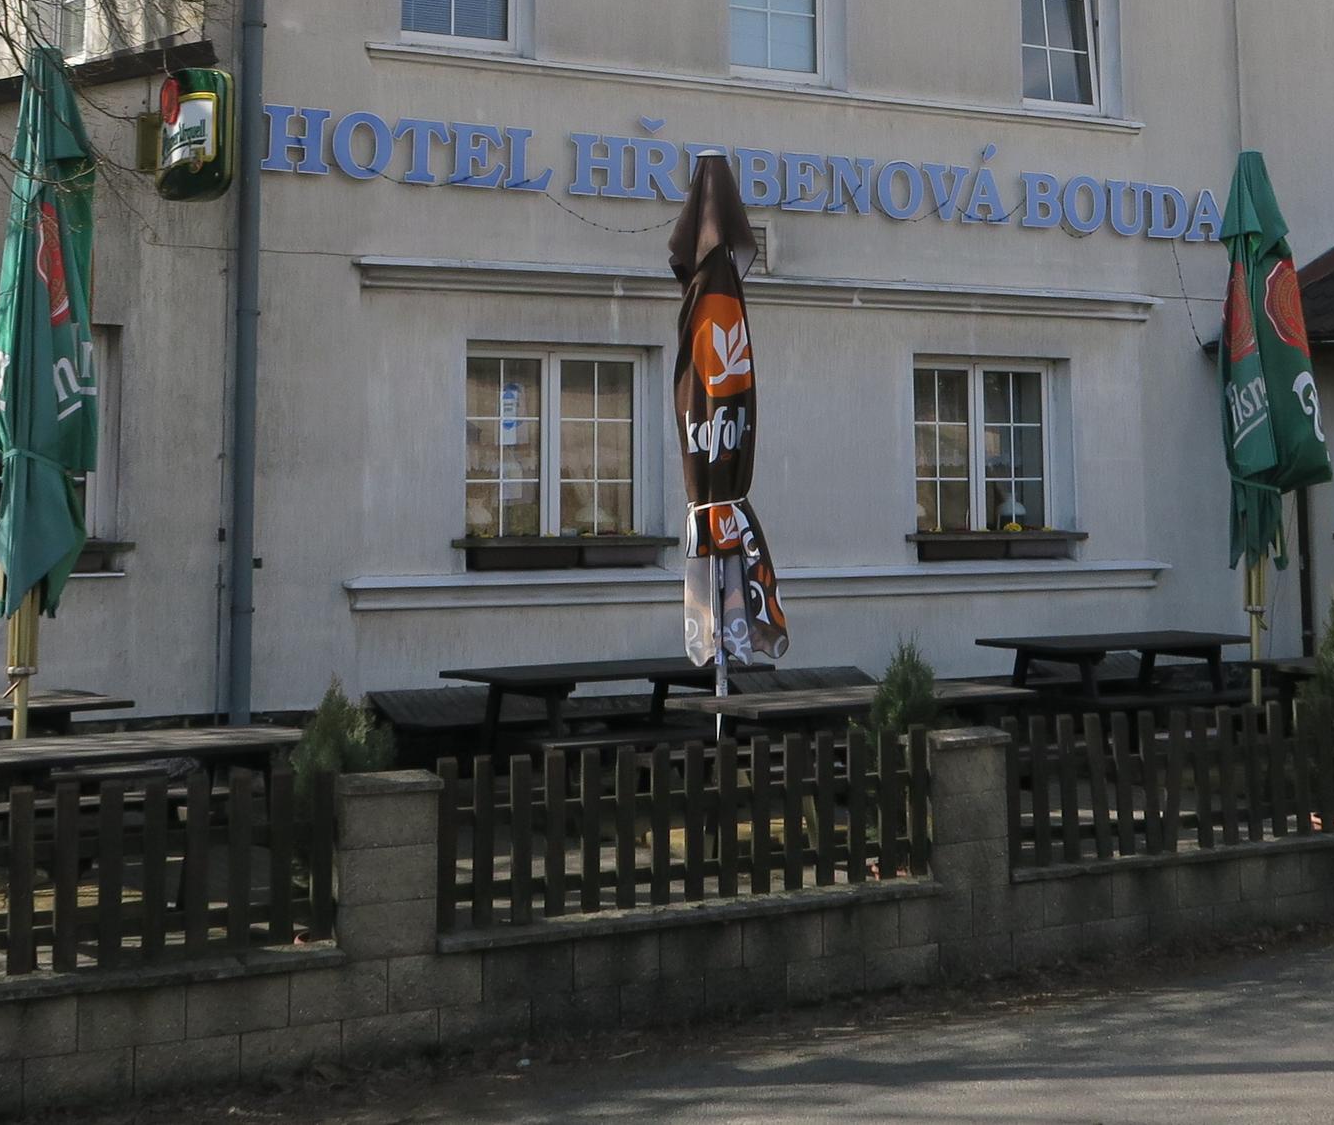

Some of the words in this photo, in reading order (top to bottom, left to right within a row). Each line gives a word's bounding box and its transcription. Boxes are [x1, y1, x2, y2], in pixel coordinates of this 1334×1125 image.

[261, 103, 553, 193] HOTEL
[1020, 170, 1225, 242] BOUDA
[1227, 376, 1268, 433] ilsn
[685, 406, 751, 463] kofol
